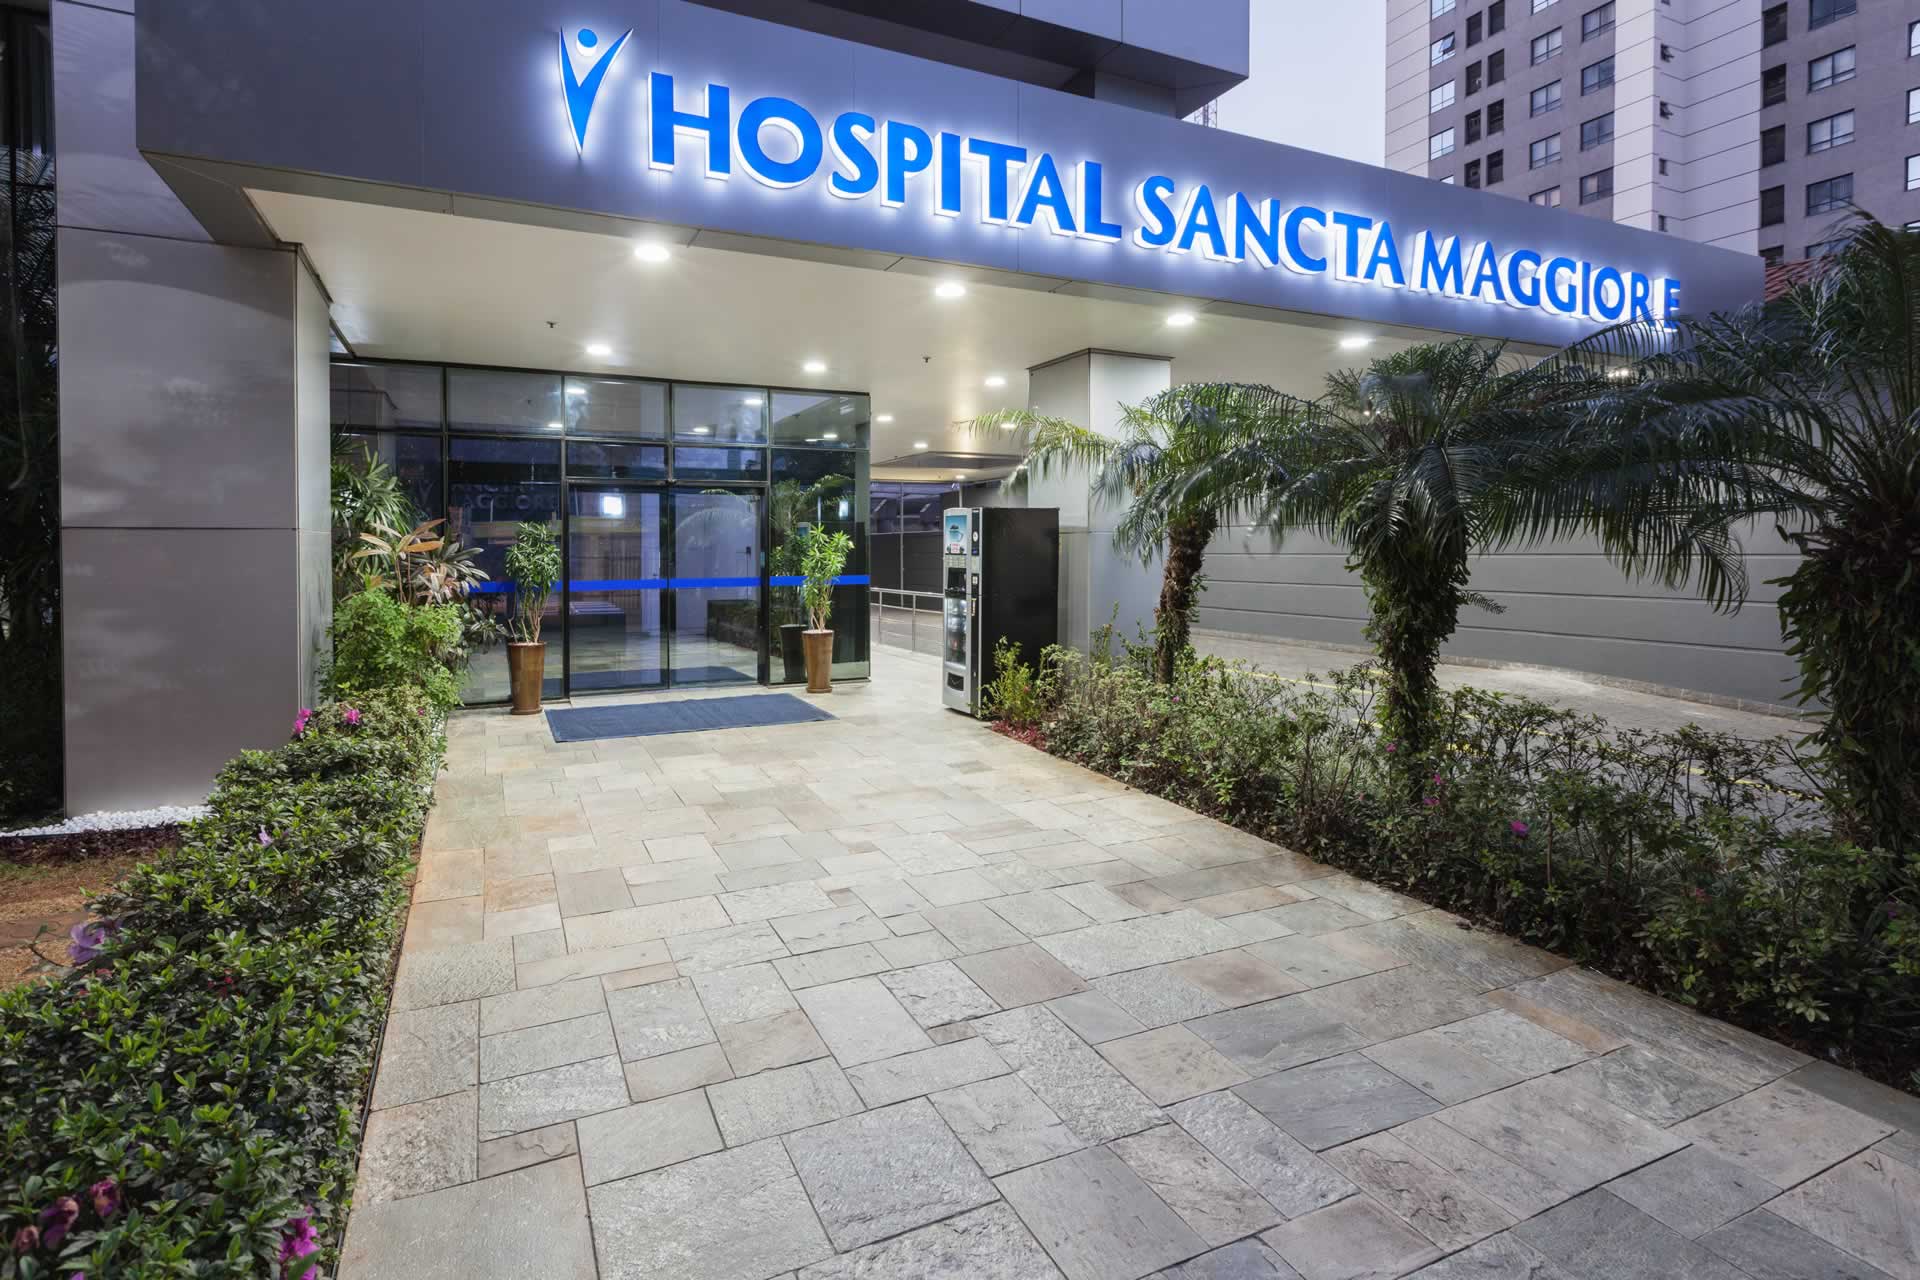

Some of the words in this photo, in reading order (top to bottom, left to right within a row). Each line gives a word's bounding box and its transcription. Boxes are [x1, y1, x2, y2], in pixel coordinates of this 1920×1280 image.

[648, 71, 1123, 242] HOSPITAL
[1134, 175, 1406, 288] SANCTA
[1411, 229, 1681, 330] MAGGIORE
